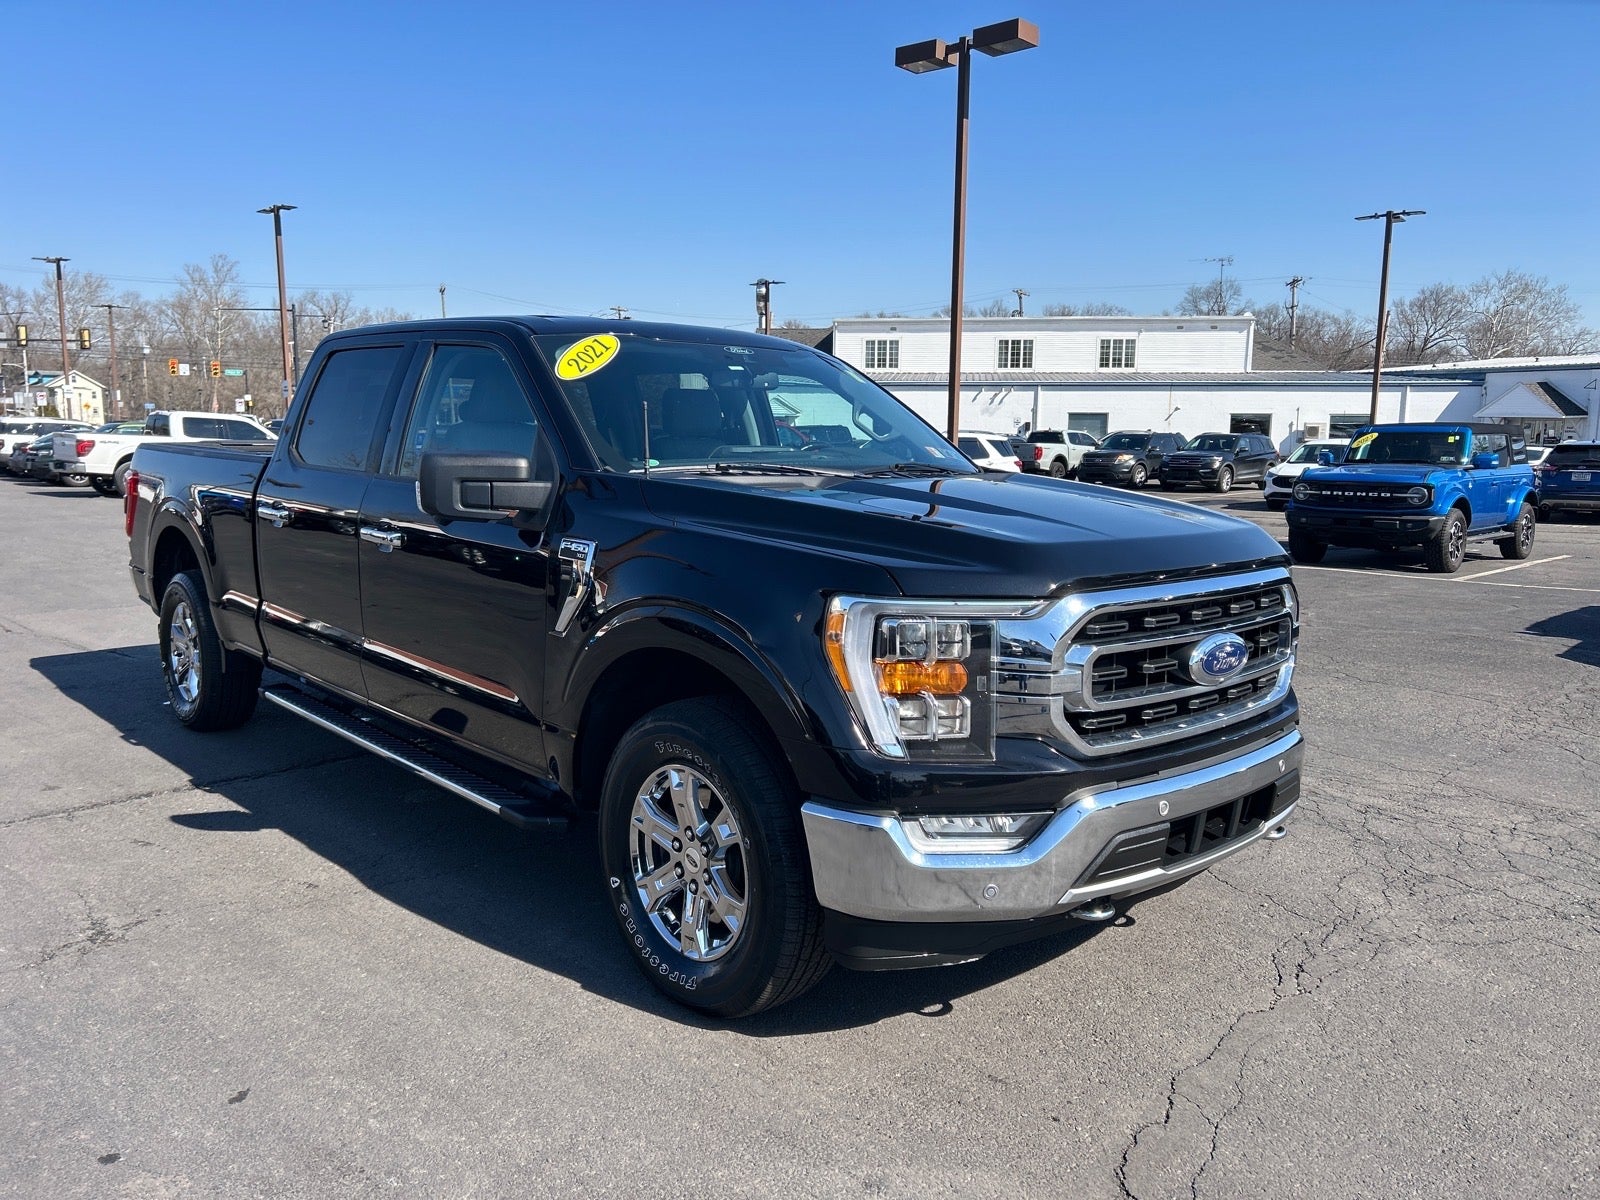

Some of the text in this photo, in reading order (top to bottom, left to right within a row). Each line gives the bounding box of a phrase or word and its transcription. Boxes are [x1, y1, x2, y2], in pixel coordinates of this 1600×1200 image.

[567, 338, 612, 373] 2021
[561, 542, 588, 553] F-150
[1211, 645, 1240, 671] Ford
[619, 903, 697, 990] Firestone
